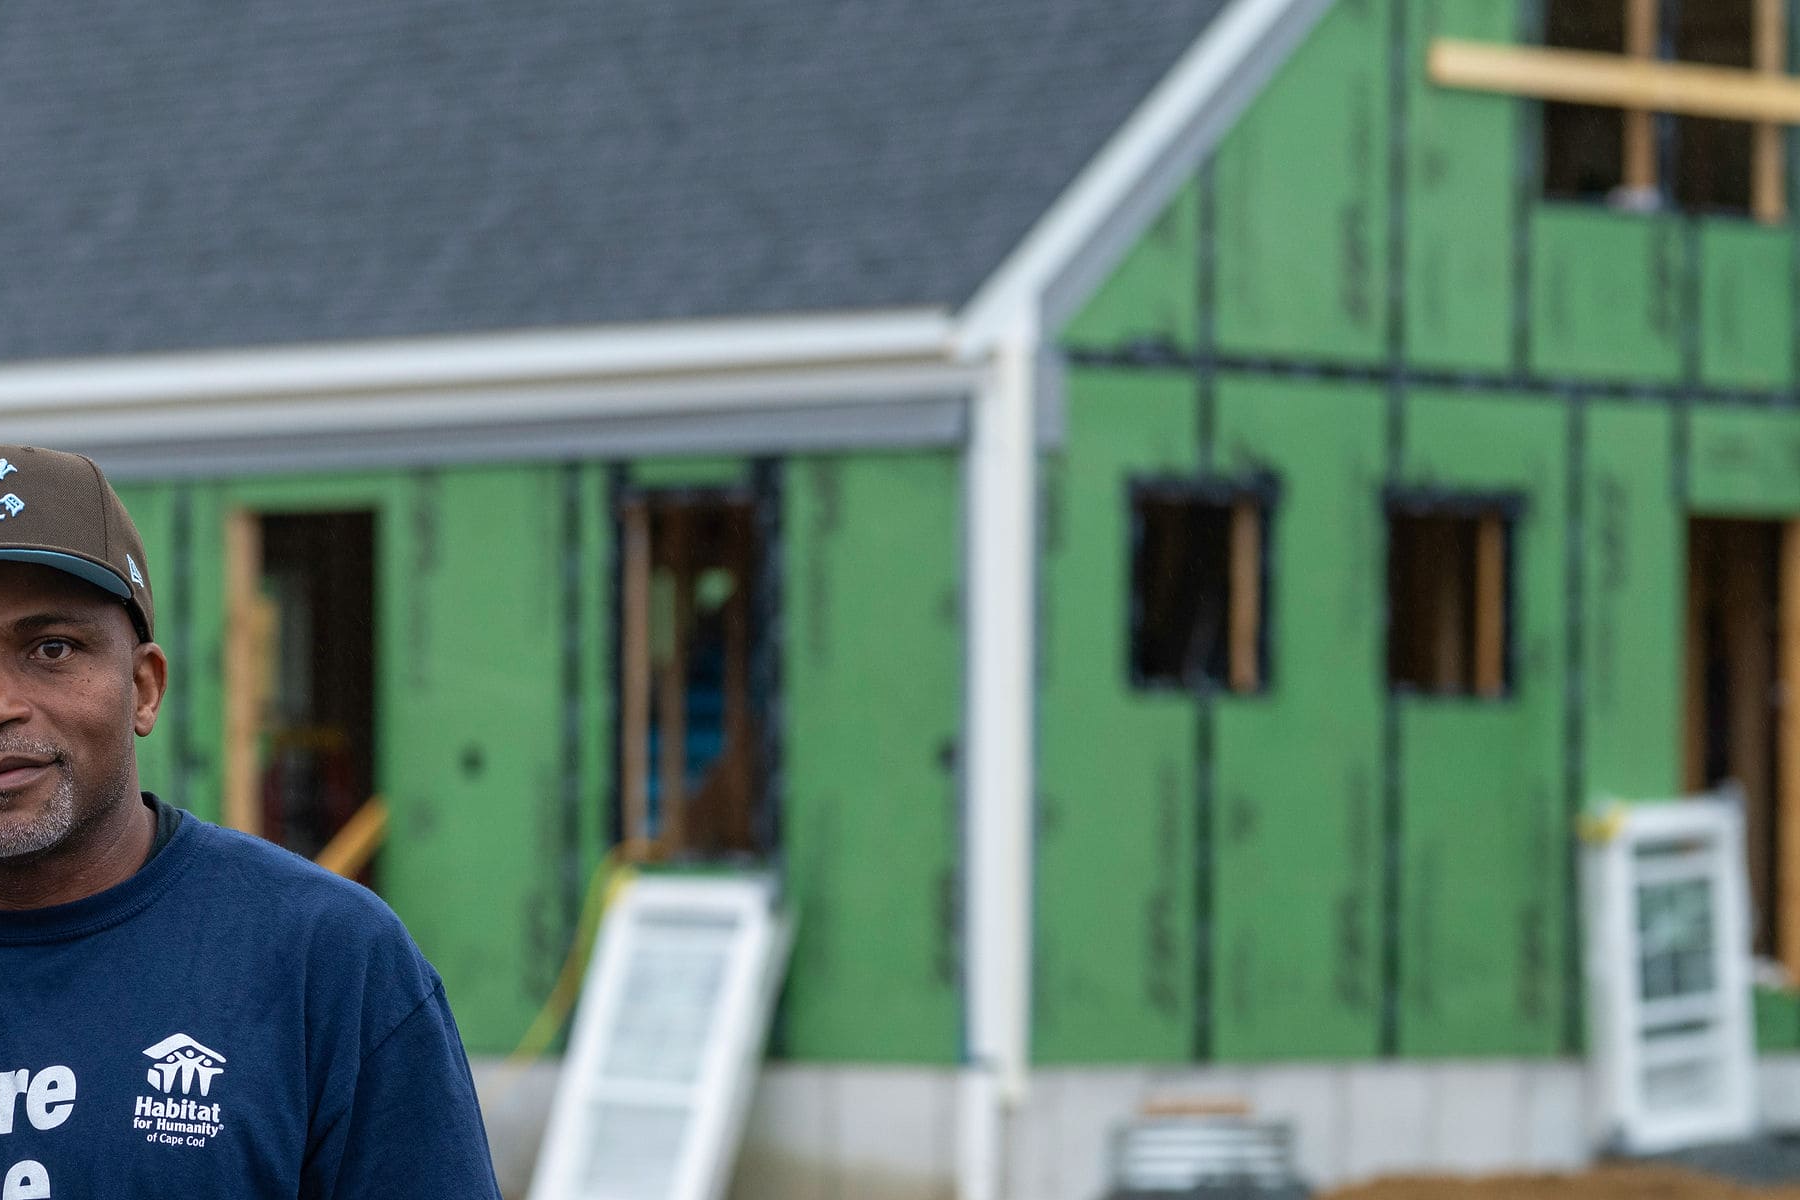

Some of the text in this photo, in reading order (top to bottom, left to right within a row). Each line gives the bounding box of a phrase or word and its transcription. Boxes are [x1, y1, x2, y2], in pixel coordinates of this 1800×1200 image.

[134, 1096, 221, 1123] Habitat
[133, 1117, 152, 1129] for
[146, 1132, 206, 1147] of Cape Cod
